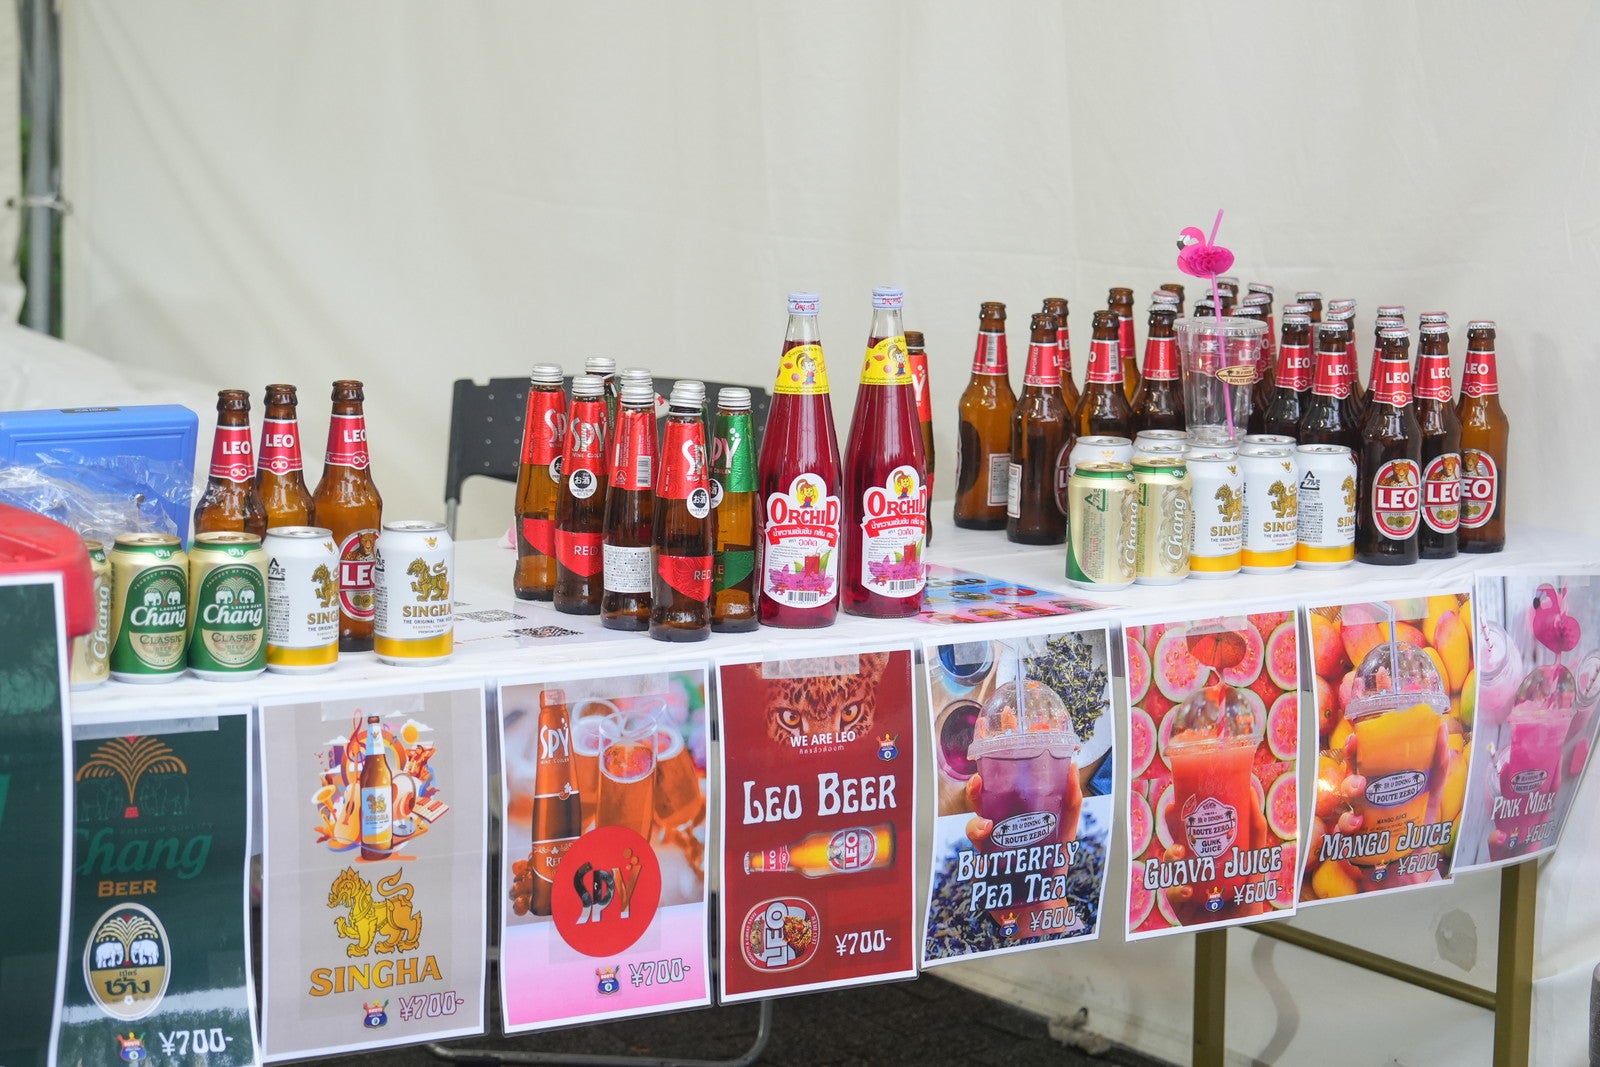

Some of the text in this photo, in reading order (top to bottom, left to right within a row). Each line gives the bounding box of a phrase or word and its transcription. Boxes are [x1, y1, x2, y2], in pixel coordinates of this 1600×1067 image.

[1286, 357, 1311, 369] LEO
[1327, 364, 1349, 376] LEO
[1465, 362, 1489, 375] LEO
[1385, 371, 1410, 384] LEO
[343, 429, 367, 444] LEO
[544, 409, 567, 443] SP
[570, 417, 607, 452] SPY
[222, 440, 250, 456] LEO
[264, 433, 295, 449] LEO
[681, 439, 705, 475] SP
[711, 437, 741, 468] PY
[573, 475, 591, 485] お酒
[1461, 479, 1492, 499] EO
[868, 488, 927, 516] ORCHID
[1377, 488, 1418, 509] LEO
[1427, 483, 1461, 503] LEO
[771, 497, 839, 525] ORCHID
[1168, 498, 1187, 560] Chang
[574, 545, 599, 557] RED
[341, 564, 375, 587] LE
[693, 570, 711, 581] RED
[93, 585, 111, 660] Chang
[130, 606, 187, 628] Chang
[203, 603, 263, 627] Chang
[307, 611, 338, 625] SING
[139, 634, 183, 645] CLASSIC
[211, 632, 257, 643] CLASSIC
[540, 720, 570, 760] SPY
[790, 730, 856, 748] WE ARE LEO
[743, 772, 897, 825] LEO BEER
[1376, 787, 1416, 802] ROUTE ZERO
[1490, 791, 1557, 821] PINK MILK
[1004, 829, 1046, 845] ROUTE ZERO
[1214, 824, 1230, 832] ZERO
[846, 832, 859, 869] LEO
[1200, 845, 1222, 853] JUICE
[1319, 821, 1453, 862] MANGO JUICE
[769, 850, 777, 870] LEO
[957, 841, 1080, 882] BUTTERFLY
[1143, 846, 1283, 890] GUAVA JUICE
[98, 879, 158, 897] BEER
[574, 851, 643, 925] SPY
[969, 873, 1067, 912] PEA TEA
[766, 901, 789, 968] LEO
[309, 955, 443, 997] SINGHA
